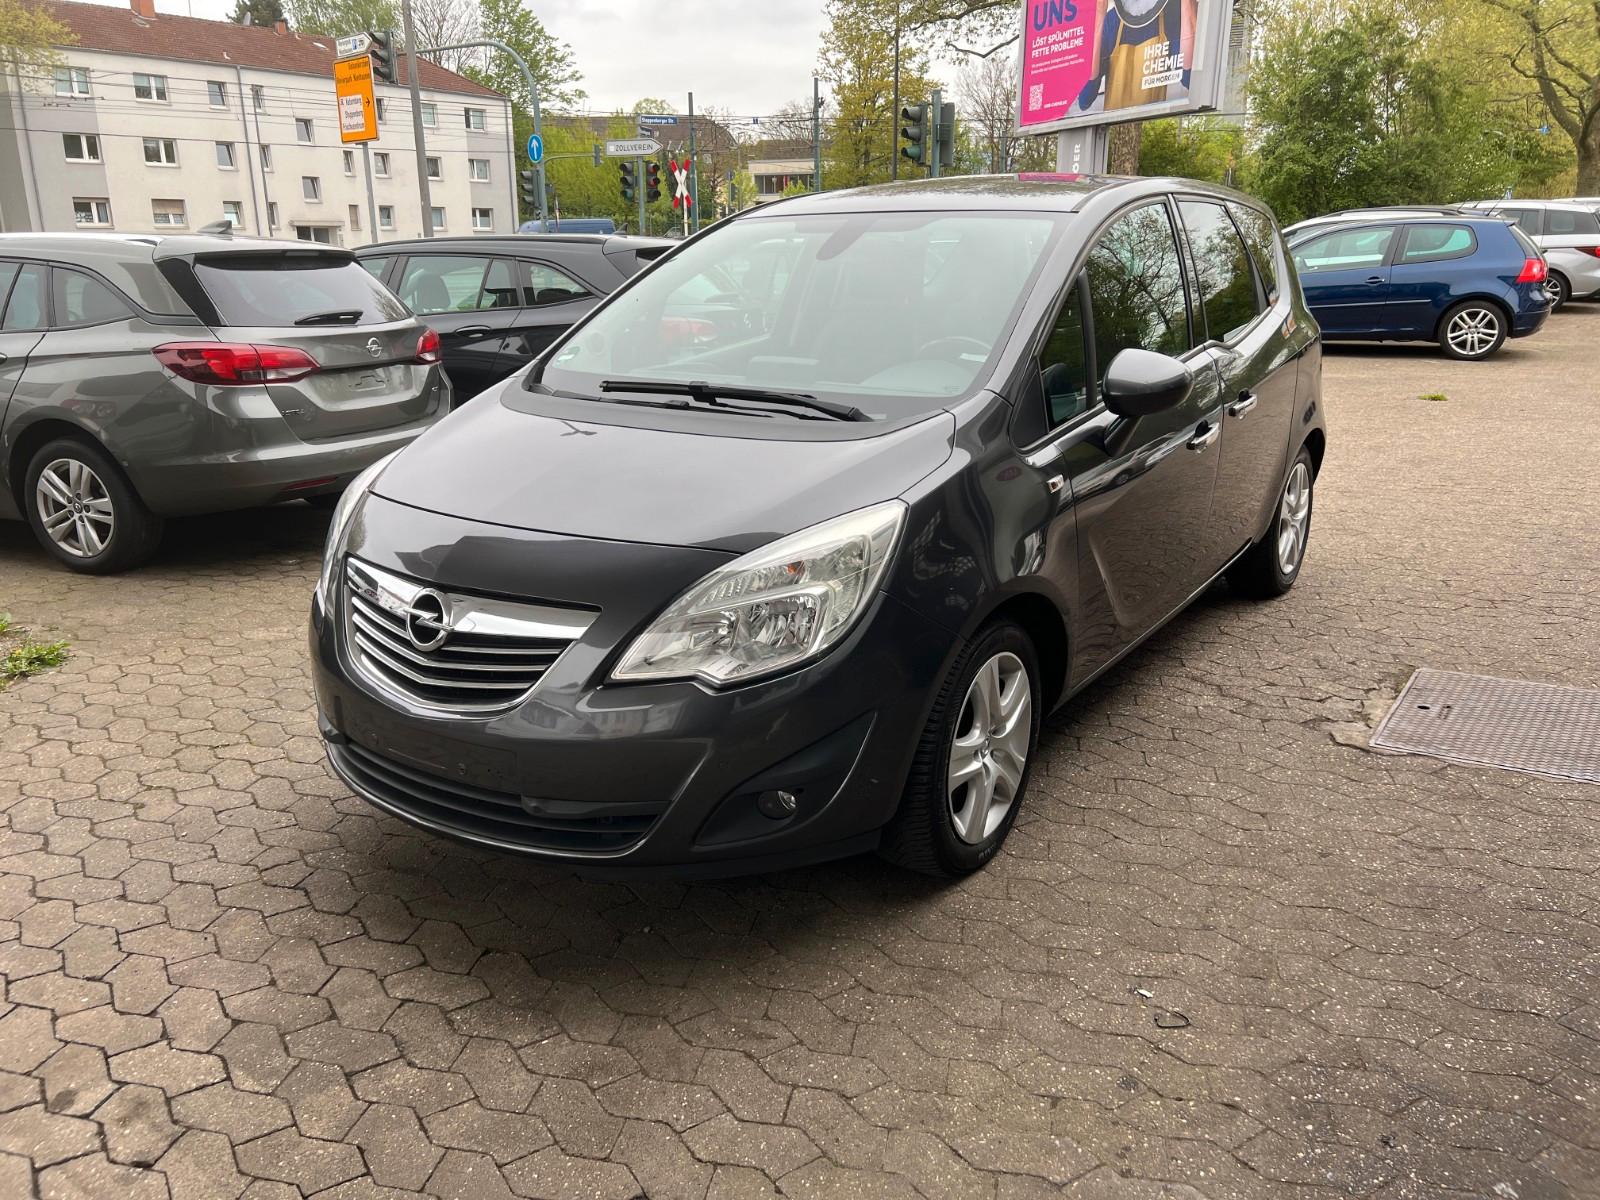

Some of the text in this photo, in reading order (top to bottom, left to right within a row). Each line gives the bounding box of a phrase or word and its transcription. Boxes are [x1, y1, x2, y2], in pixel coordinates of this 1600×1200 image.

[1033, 0, 1078, 31] UNS
[1032, 26, 1085, 48] LÖST SPÜLMITTEL
[1032, 37, 1084, 59] FETTE PROBLEME
[1144, 41, 1170, 60] IHRE
[1142, 53, 1185, 75] CHEMIE
[1144, 71, 1180, 86] FÜR MORGEN
[615, 144, 653, 152] ZOLLVEREIN
